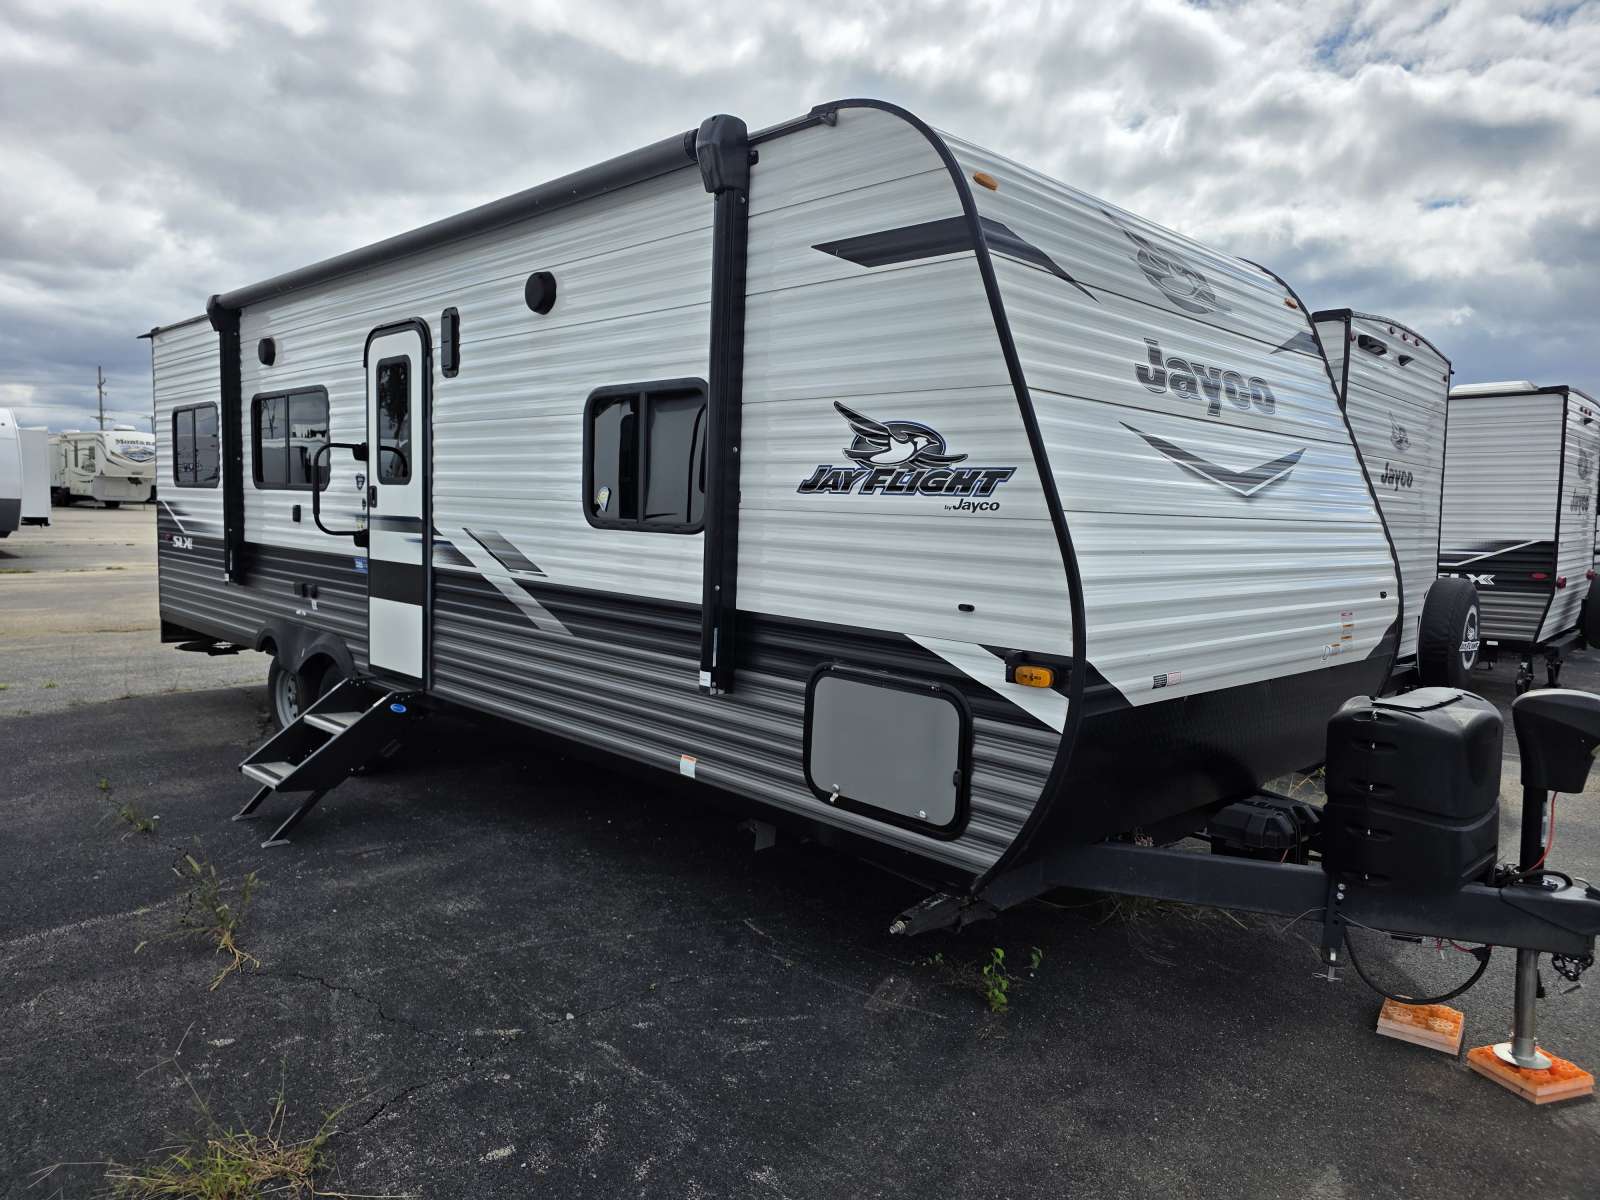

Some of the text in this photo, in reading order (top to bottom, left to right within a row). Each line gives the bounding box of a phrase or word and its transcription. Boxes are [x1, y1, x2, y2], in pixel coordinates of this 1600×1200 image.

[1134, 337, 1276, 417] Jayco
[797, 465, 1017, 498] JAY FLIGHT
[1380, 462, 1414, 491] Jayco
[952, 498, 1001, 513] Jayco
